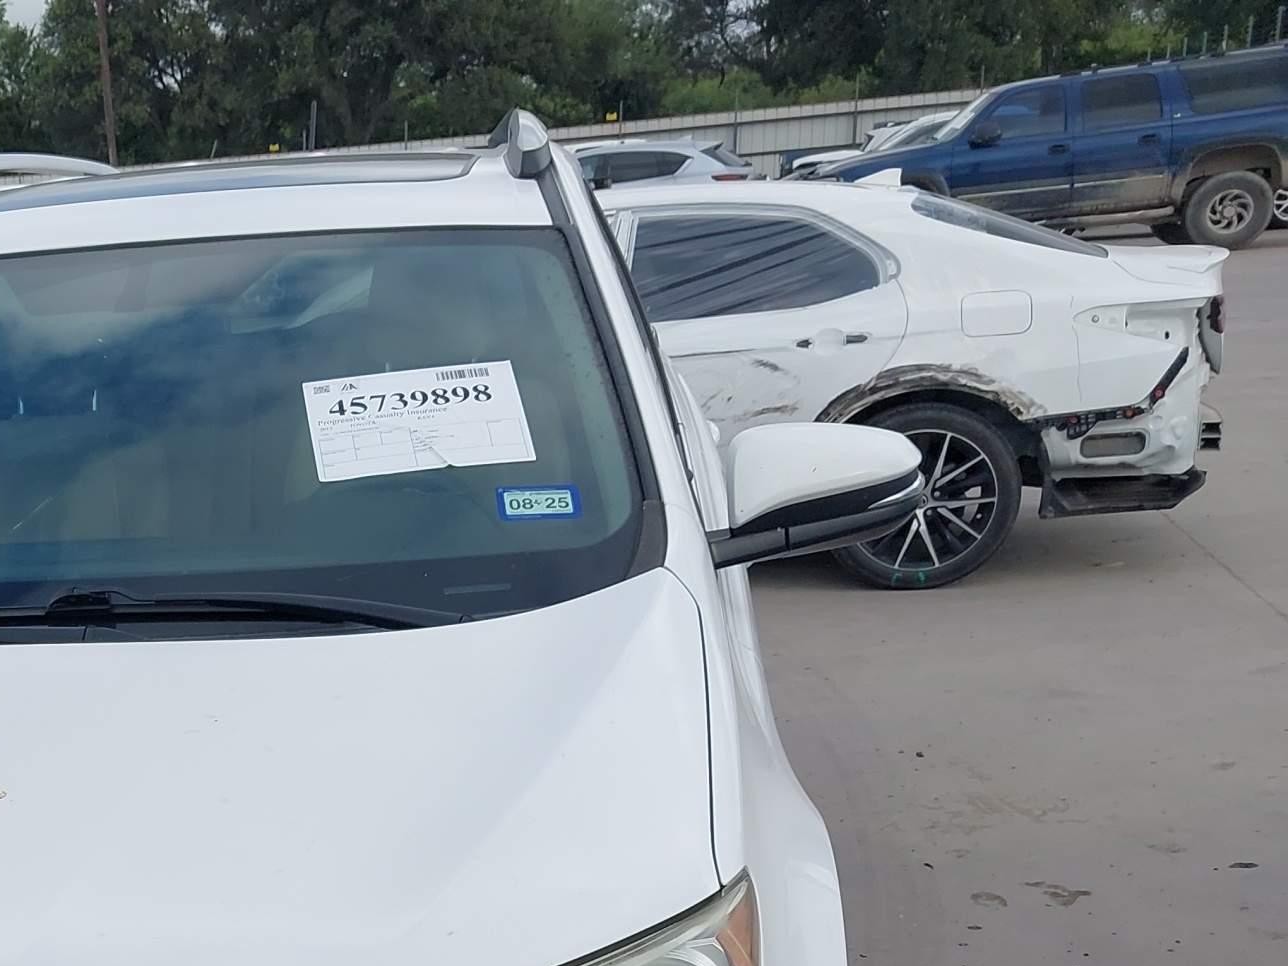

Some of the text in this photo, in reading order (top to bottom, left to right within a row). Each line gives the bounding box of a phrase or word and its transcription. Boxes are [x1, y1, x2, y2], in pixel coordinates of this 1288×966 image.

[329, 384, 492, 416] 45739898
[318, 415, 365, 426] Progressive
[407, 407, 447, 416] Insurance
[509, 497, 569, 510] 08 25
